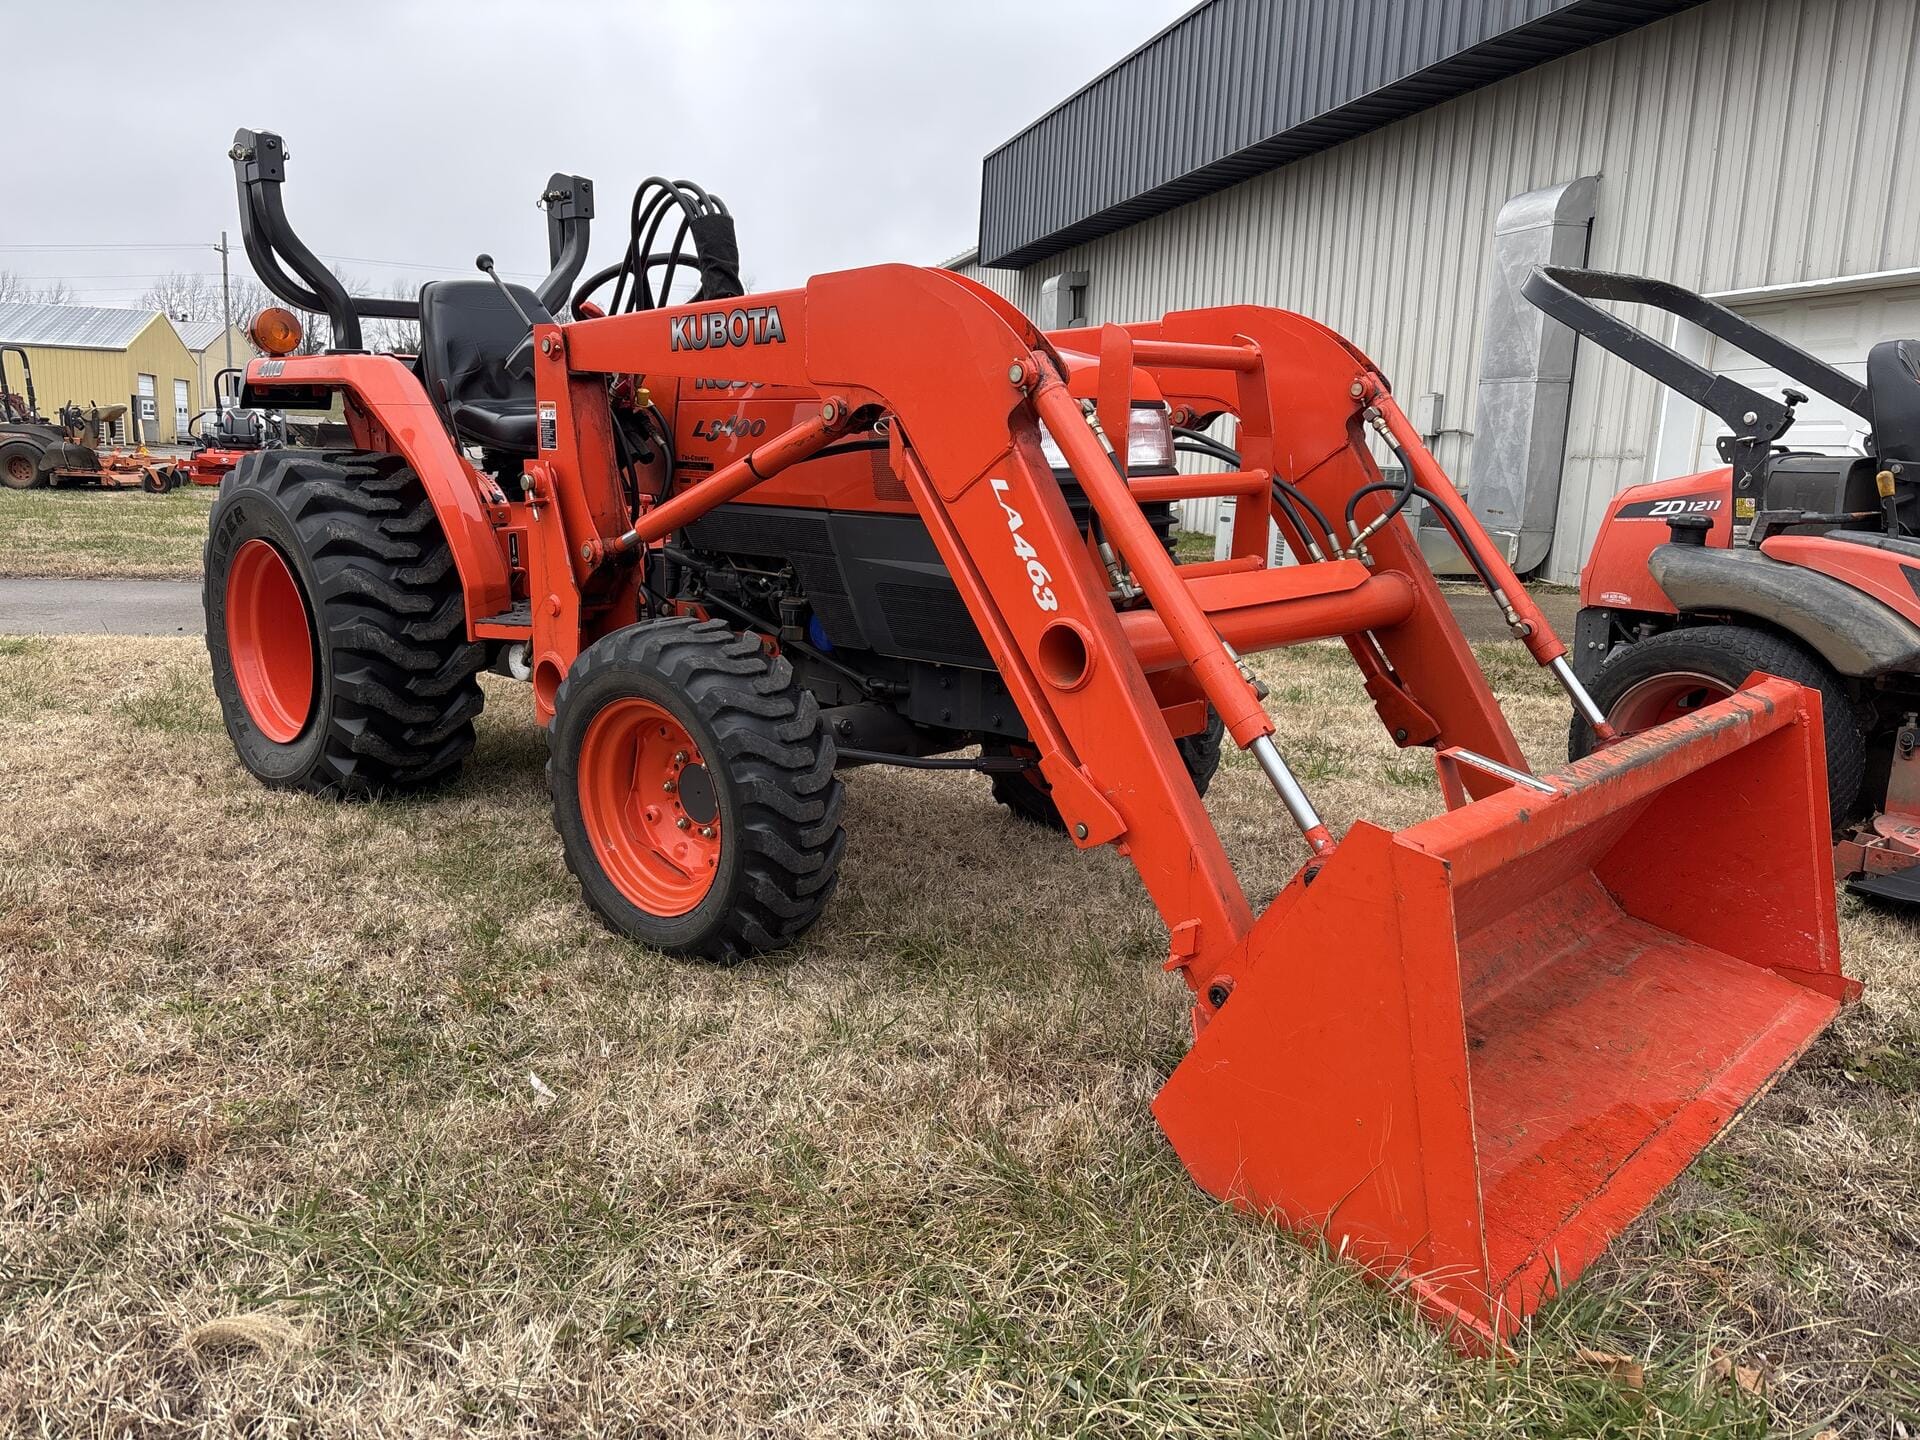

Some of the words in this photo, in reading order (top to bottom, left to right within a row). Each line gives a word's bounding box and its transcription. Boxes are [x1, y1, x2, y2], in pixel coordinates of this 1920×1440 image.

[670, 306, 786, 352] KUBOTA
[692, 415, 767, 442] L3400
[989, 479, 1058, 611] LA463
